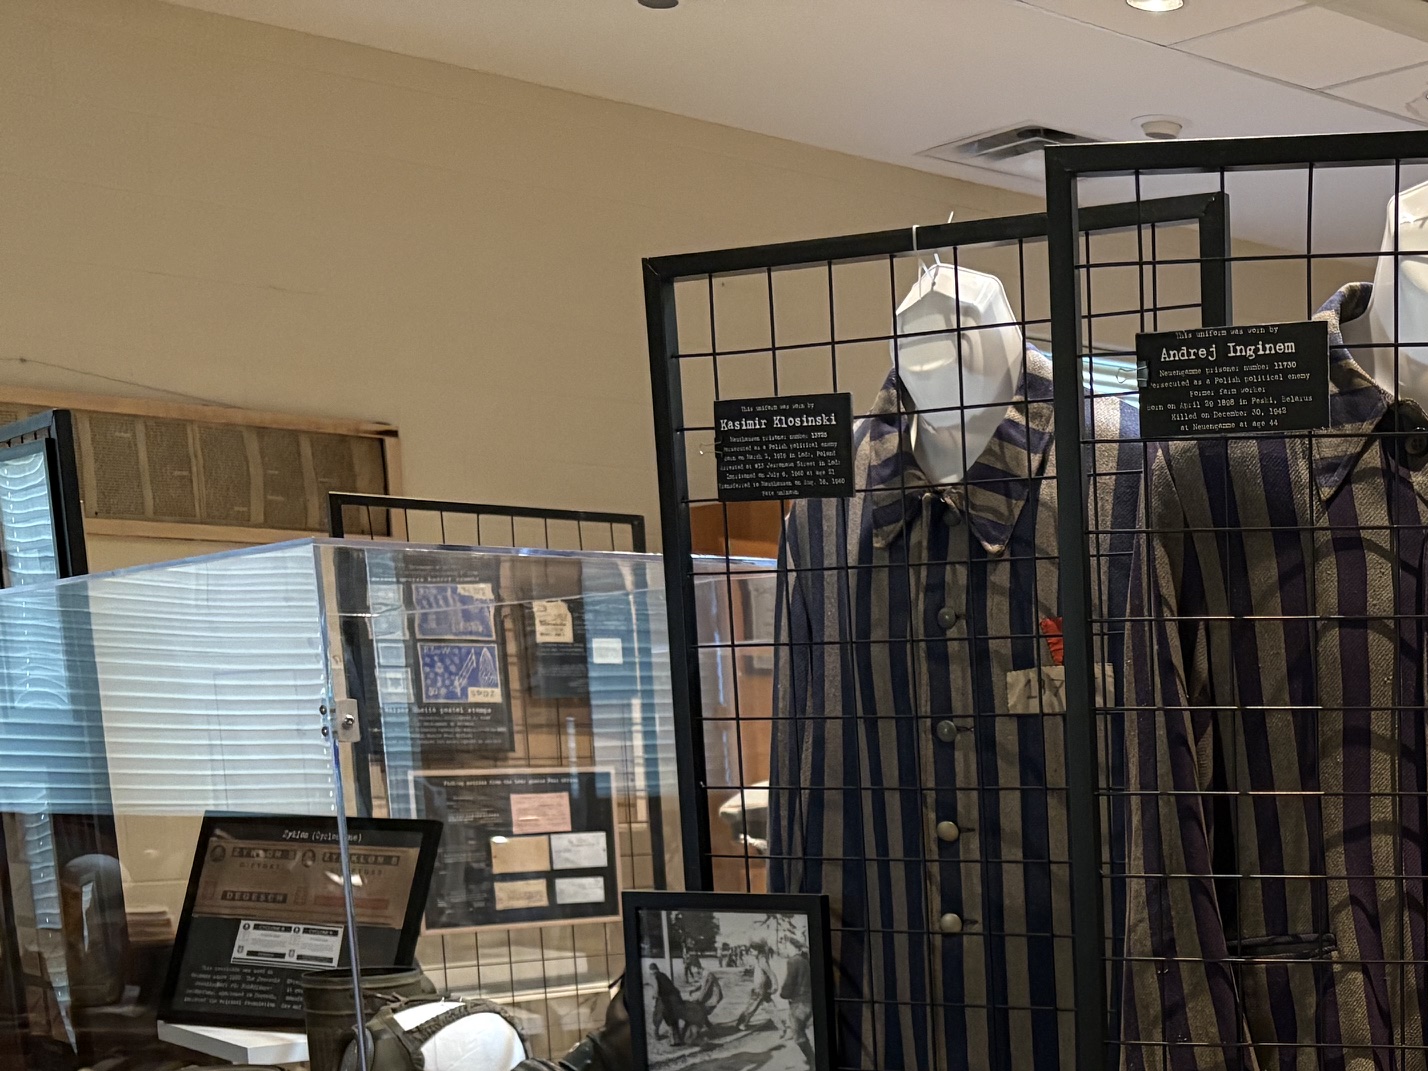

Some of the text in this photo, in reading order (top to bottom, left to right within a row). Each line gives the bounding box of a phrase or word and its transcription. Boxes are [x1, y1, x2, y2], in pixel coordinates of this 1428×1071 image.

[1196, 330, 1227, 338] uniform
[1269, 326, 1278, 334] by
[1161, 341, 1295, 362] Andrej Inginem
[1159, 361, 1297, 377] Neuengamme prisoner number 11730
[1214, 376, 1241, 384] Polish
[1244, 373, 1283, 383] political
[1189, 390, 1214, 398] Former
[1180, 400, 1200, 410] April
[1204, 400, 1214, 408] 29
[1281, 394, 1312, 403] Belarus
[1171, 412, 1198, 421] Killed
[1213, 409, 1247, 418] December
[720, 413, 837, 431] Kasimir Klosinski
[1193, 422, 1236, 431] Neuengamme
[1252, 420, 1266, 429] age
[282, 830, 309, 840] Zyklon
[226, 892, 283, 902] DEGESCH
